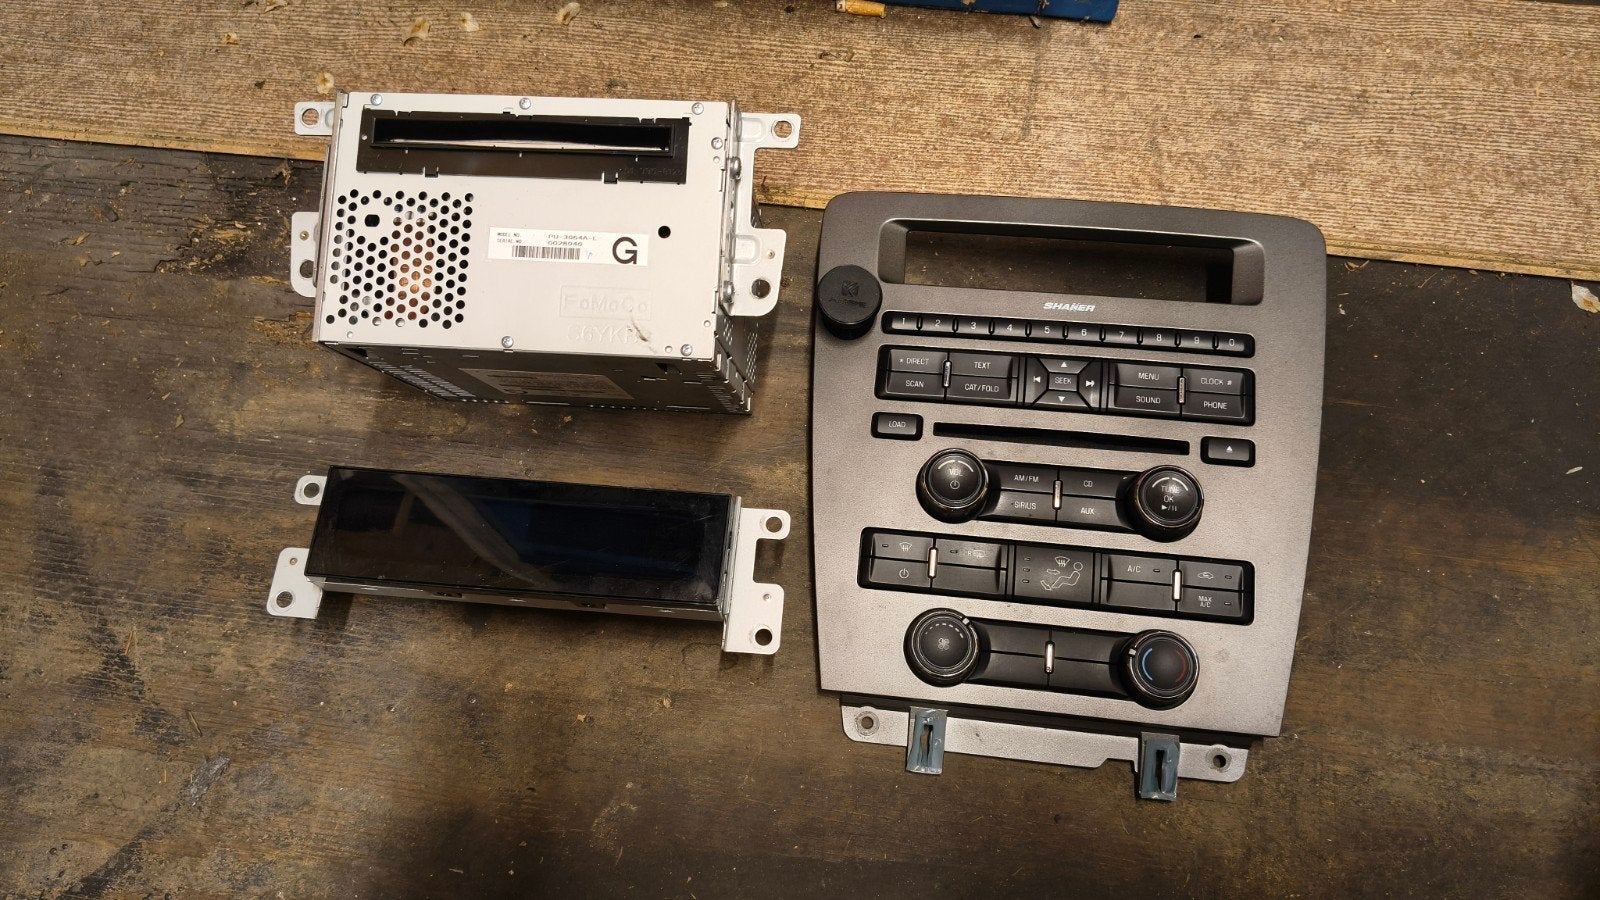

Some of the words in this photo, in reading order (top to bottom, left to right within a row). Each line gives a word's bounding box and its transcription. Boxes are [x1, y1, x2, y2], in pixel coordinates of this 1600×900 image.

[612, 236, 638, 265] G
[1043, 302, 1096, 312] SHAKER
[901, 317, 906, 325] 1
[935, 319, 941, 327] 2
[1081, 328, 1087, 336] 6
[1156, 333, 1162, 341] 8
[1194, 336, 1200, 344] 9
[1228, 338, 1235, 346] 0
[973, 361, 991, 369] TEXT
[1055, 376, 1072, 384] SEEK
[1138, 372, 1160, 380] MENU
[905, 380, 924, 388] SCAN
[1200, 377, 1223, 385] CLOCK
[964, 383, 1000, 392] CAT/FOLD
[1135, 395, 1161, 404] SOUND
[1203, 401, 1227, 409] PHONE
[949, 468, 963, 477] VOL
[1014, 474, 1039, 482] AM/FM
[1083, 480, 1093, 488] CD
[1161, 485, 1180, 494] TUNE
[1163, 495, 1175, 503] OK
[1014, 501, 1037, 510] SIRIUS
[1080, 507, 1095, 515] AUX
[1127, 565, 1141, 573] A/C
